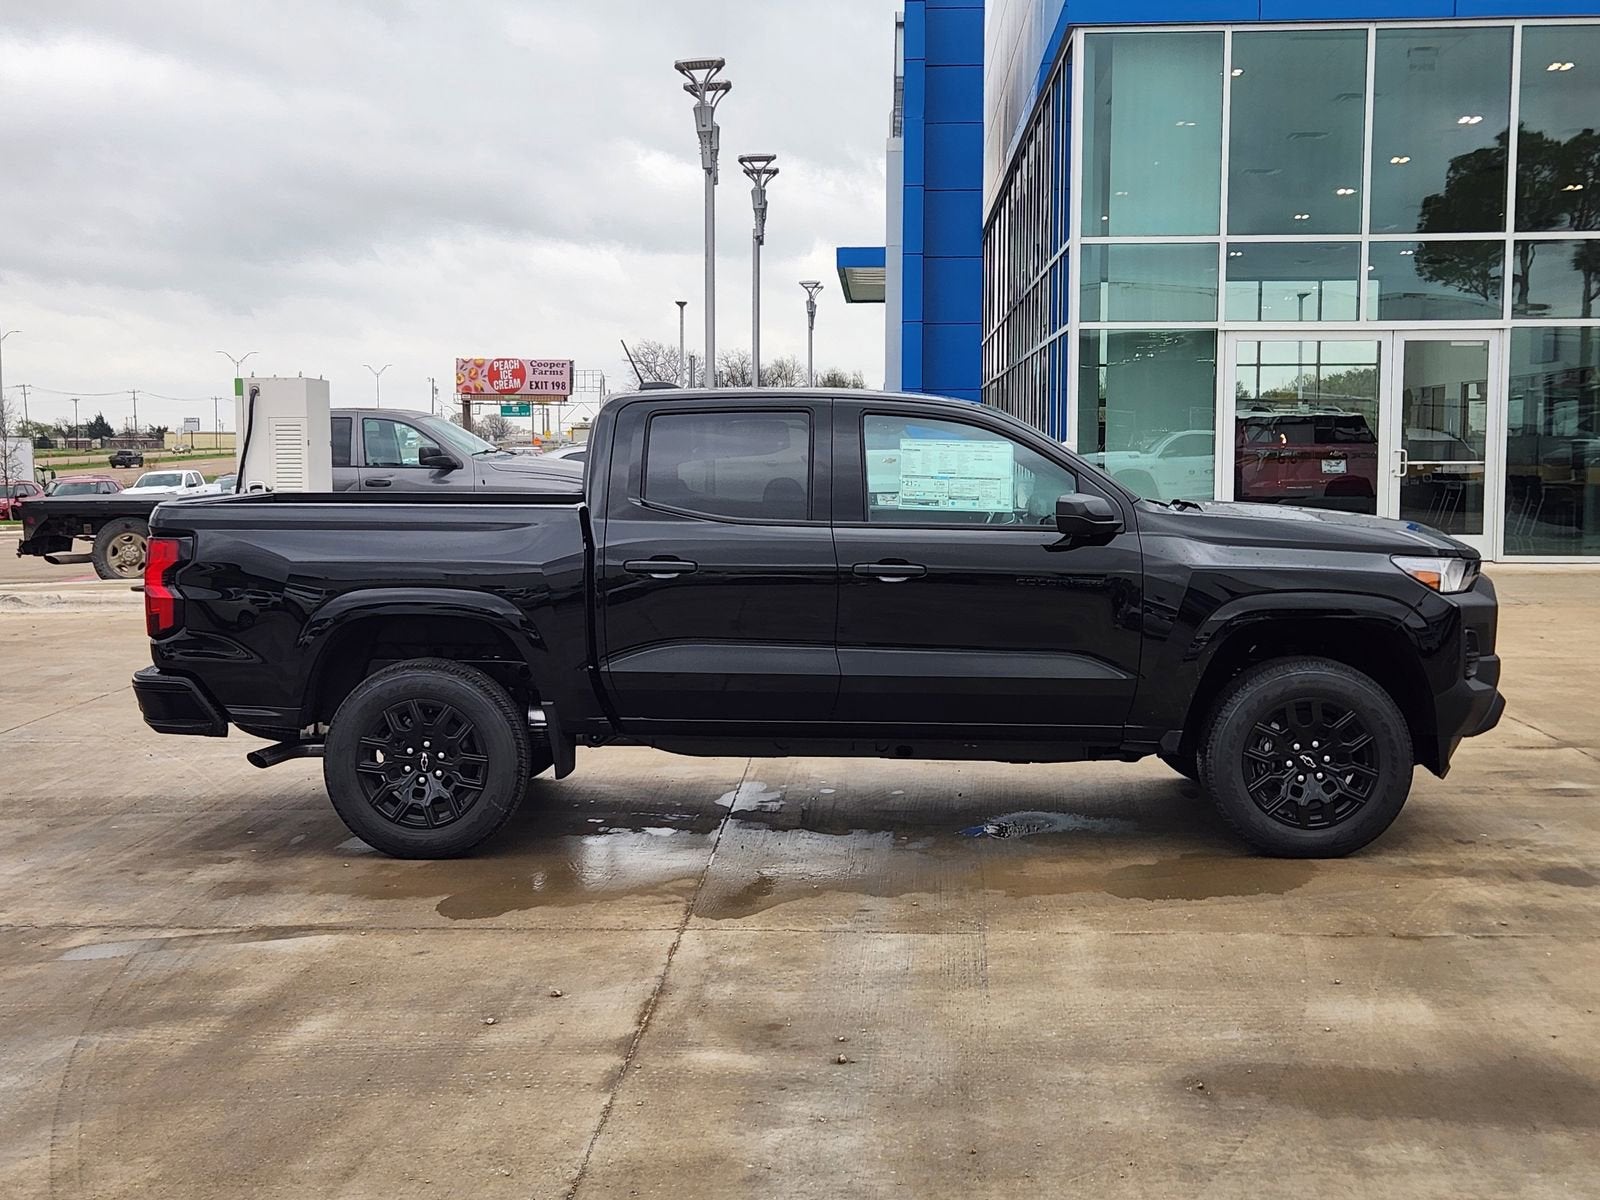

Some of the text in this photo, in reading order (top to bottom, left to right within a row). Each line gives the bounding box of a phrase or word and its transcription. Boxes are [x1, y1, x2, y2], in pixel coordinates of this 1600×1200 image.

[493, 360, 520, 371] PEACH
[529, 360, 567, 369] Cooper
[500, 370, 513, 380] ICE
[532, 368, 564, 376] Farms
[493, 379, 521, 390] CREAM
[529, 380, 567, 390] EXIT 198
